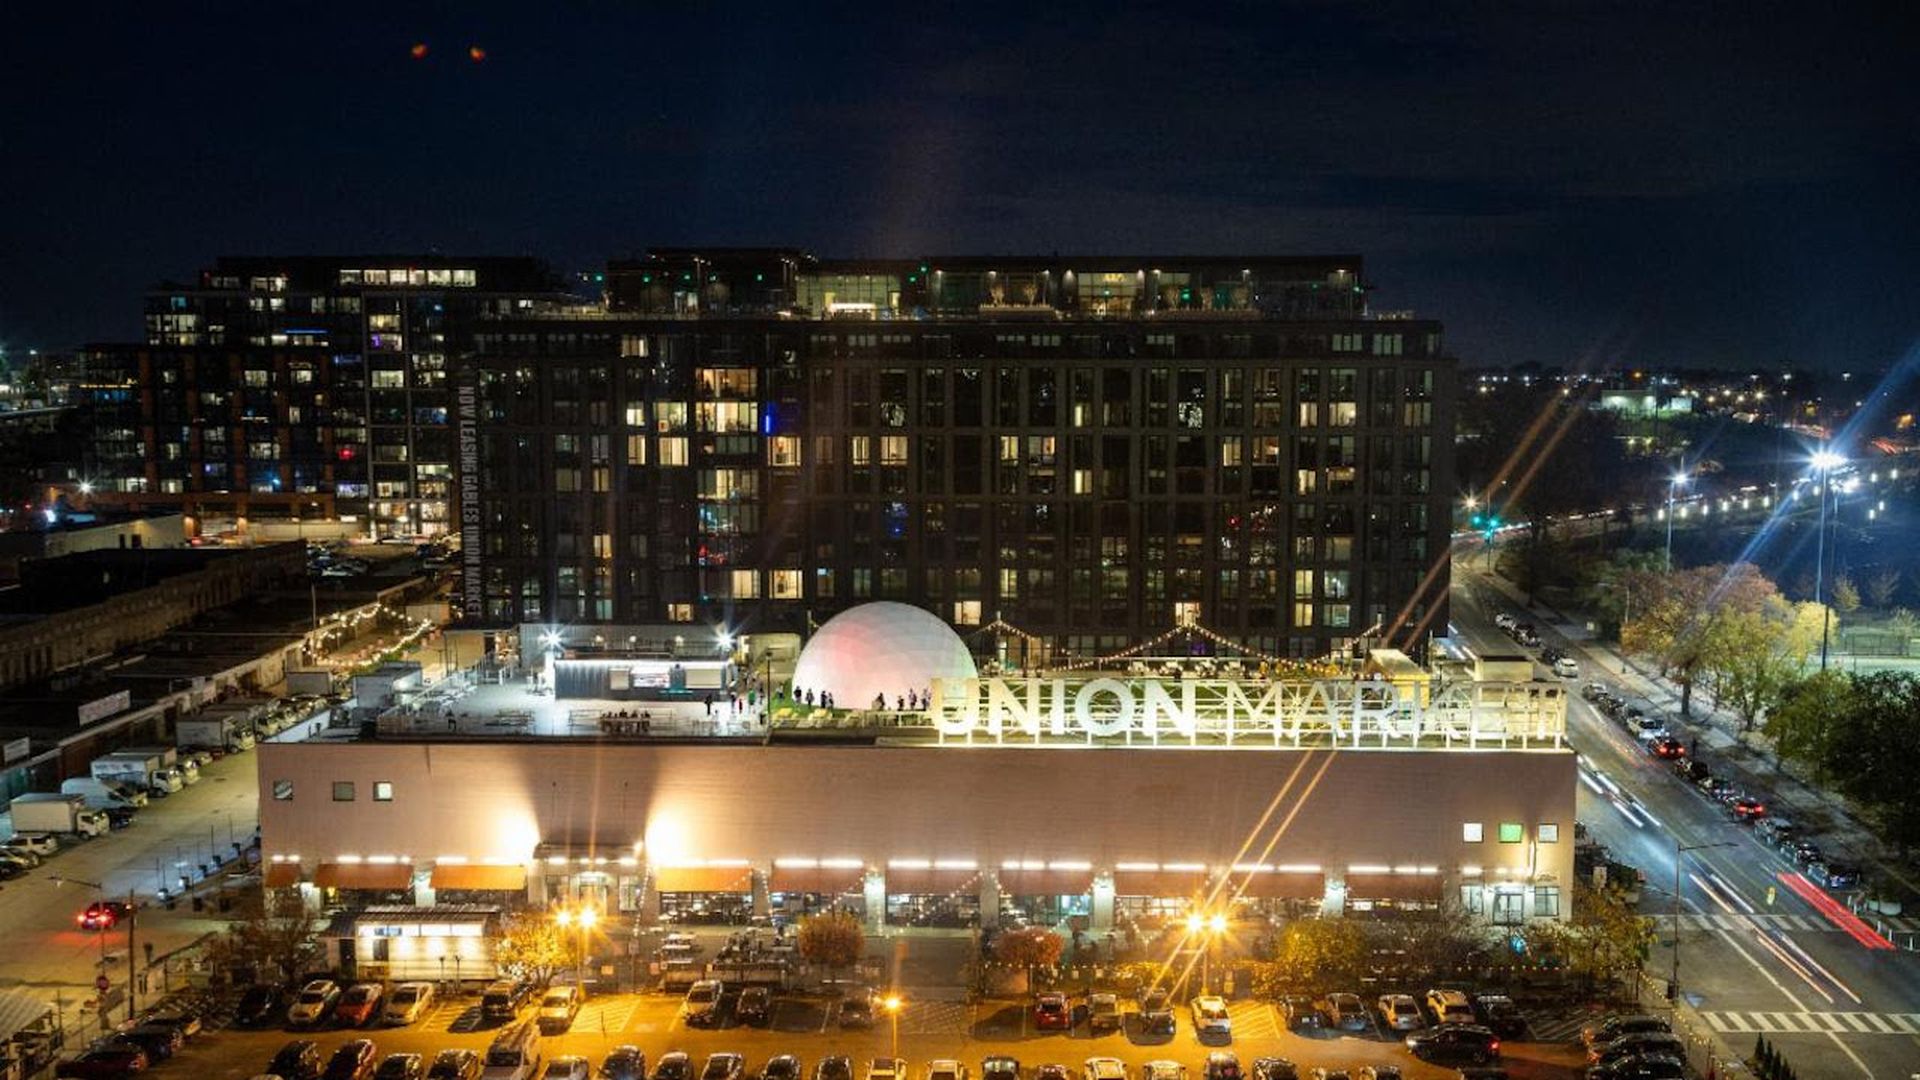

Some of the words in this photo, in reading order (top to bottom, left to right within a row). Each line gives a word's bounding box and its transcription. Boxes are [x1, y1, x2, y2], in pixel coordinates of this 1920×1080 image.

[458, 386, 475, 418] NOW
[460, 420, 478, 473] LEASING
[461, 475, 479, 523] GABLES
[463, 526, 480, 564] UNION
[465, 566, 482, 617] MARKET
[931, 678, 1196, 736] UNION
